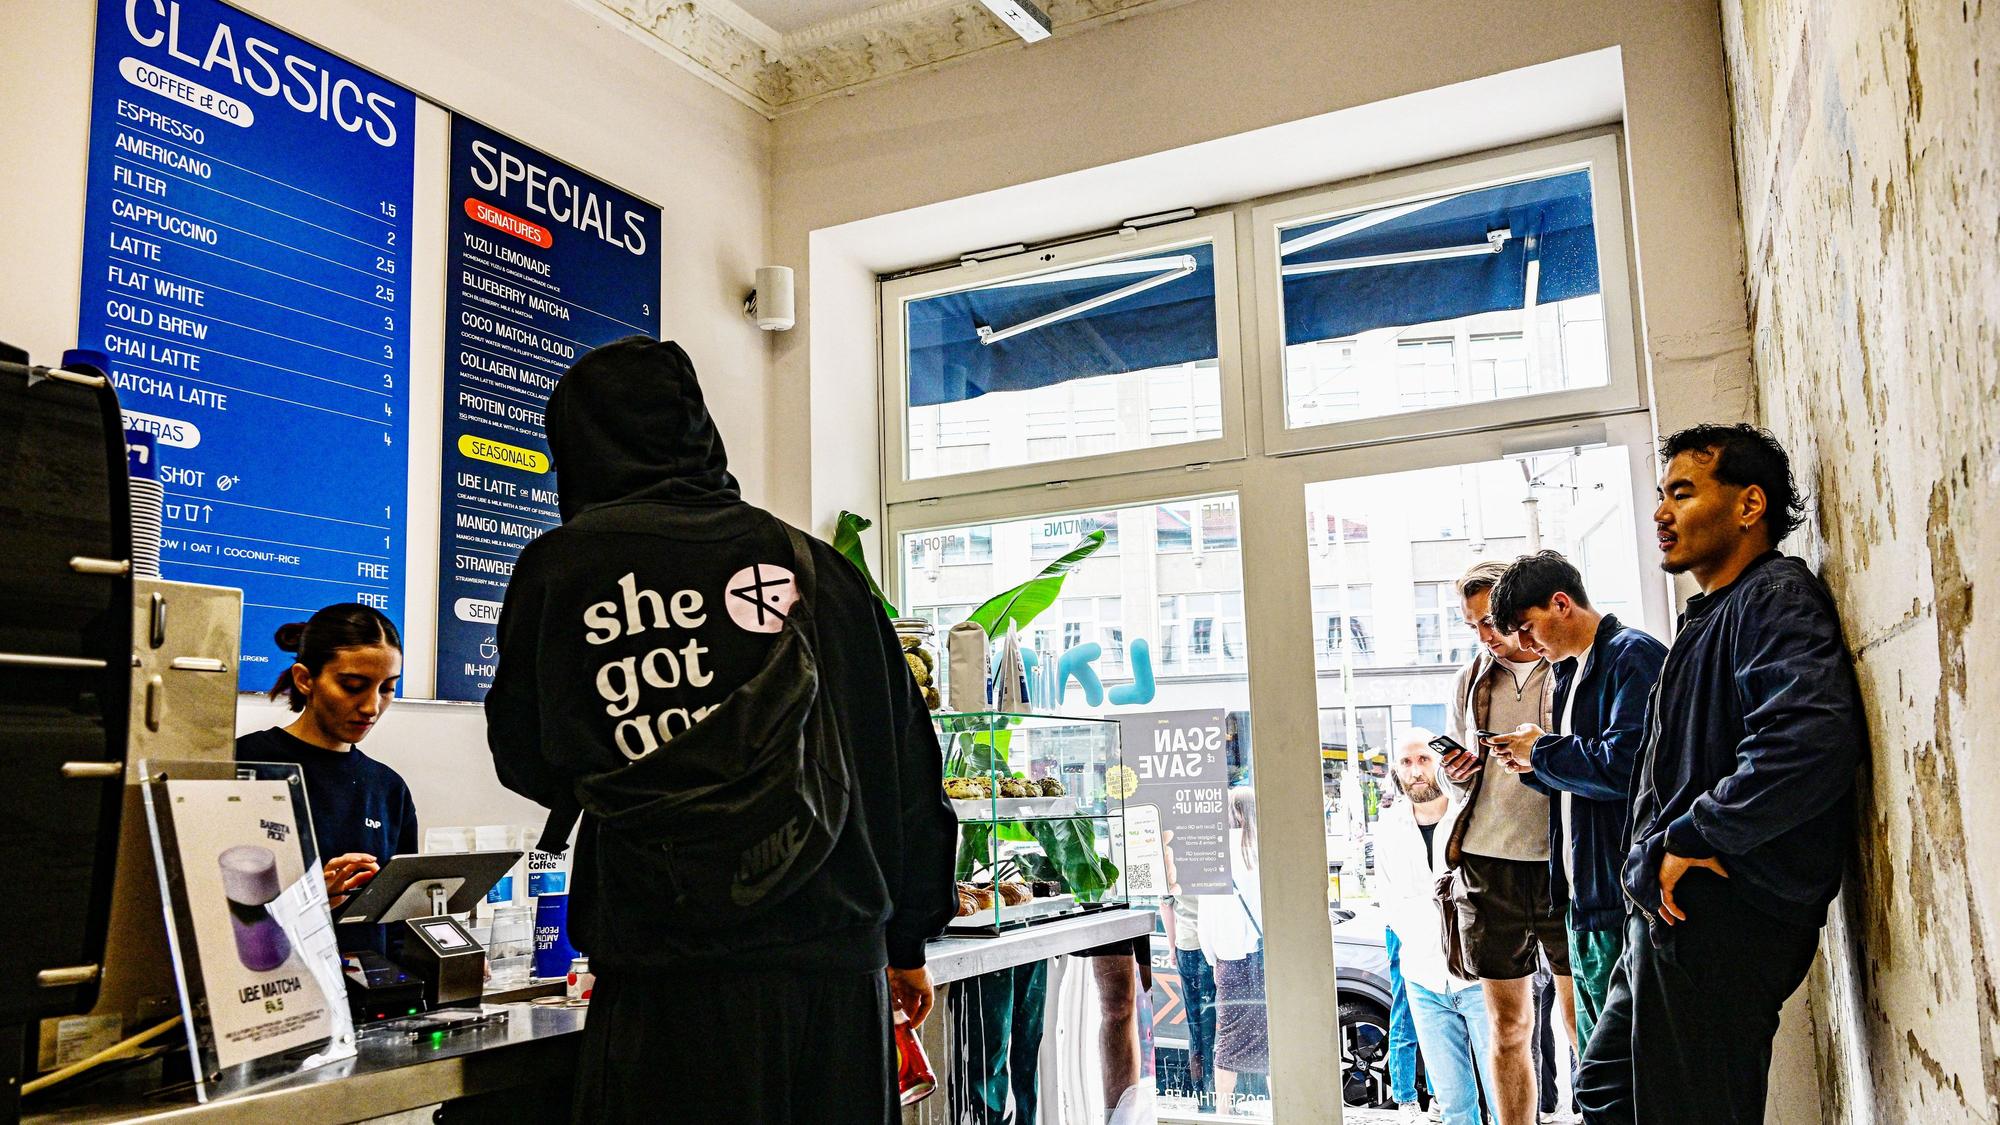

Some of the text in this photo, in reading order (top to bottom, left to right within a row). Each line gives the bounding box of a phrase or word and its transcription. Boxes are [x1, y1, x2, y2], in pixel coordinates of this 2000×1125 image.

[124, 0, 397, 147] CLASSICS
[136, 66, 195, 103] COFFEE
[218, 99, 239, 120] CO
[117, 99, 205, 145] ESPRESSO
[115, 133, 211, 180] AMERICANO
[113, 165, 167, 197] FILTER
[379, 200, 396, 218] 1.5
[470, 140, 647, 256] SPECIALS
[111, 198, 218, 246] CAPPUCCINO
[476, 205, 542, 243] SIGNATURES
[110, 232, 162, 262] LATTE
[386, 231, 396, 246] 2
[376, 256, 395, 274] 2.5
[463, 231, 551, 277] YUZU LEMONADE
[462, 251, 489, 266] HOMEMADE
[506, 268, 523, 279] GINGER
[523, 274, 547, 288] LEMONADE
[108, 266, 205, 307] FLAT WHITE
[375, 284, 395, 302] 2.5
[462, 271, 570, 321] BLUEBERRY MATCHA
[106, 300, 208, 340] COLD BREW
[384, 316, 394, 331] 3
[515, 309, 534, 320] MATCHA
[642, 303, 650, 317] 3
[461, 311, 575, 359] COCO MATCHA CLOUD
[105, 334, 201, 371] CHAI LATTE
[383, 345, 393, 360] 3
[460, 331, 485, 343] COCONUT
[485, 338, 502, 348] WATER
[501, 343, 513, 352] WITH
[516, 348, 534, 358] FLUFFY
[533, 354, 551, 364] MATCHA
[550, 359, 564, 367] FOAM
[460, 351, 517, 380] COLLAGEN
[383, 374, 393, 389] 3
[459, 371, 480, 382] MATCHA
[480, 377, 494, 386] LATTE
[494, 381, 507, 390] WITH
[507, 384, 527, 395] PREMIUM
[178, 382, 228, 411] LATTE
[383, 402, 393, 417] 4
[459, 392, 546, 427] PROTEIN COFFEE
[121, 415, 185, 442] XTRAS
[467, 414, 488, 424] PROTEIN
[503, 424, 516, 432] WITH
[383, 432, 393, 447] 4
[471, 441, 537, 468] SEASONALS
[160, 465, 205, 488] SHOT
[457, 472, 559, 506] UBE LATTE OR MATC
[457, 492, 477, 502] CREAMY
[383, 505, 392, 520] 1
[456, 512, 498, 533] MANGO
[383, 536, 391, 550] 1
[455, 533, 475, 542] MANGO
[190, 542, 212, 554] OAT
[223, 547, 301, 566] COCONUT-RICE
[357, 561, 389, 581] FREE
[455, 575, 488, 585] STRAWBERRY
[356, 591, 389, 610] FREE
[583, 572, 707, 645] she
[595, 638, 714, 717] got
[740, 815, 800, 880] NIKE
[528, 861, 557, 870] Coffee
[538, 942, 553, 950] LIFE
[238, 976, 302, 1004] UBE MATCHA
